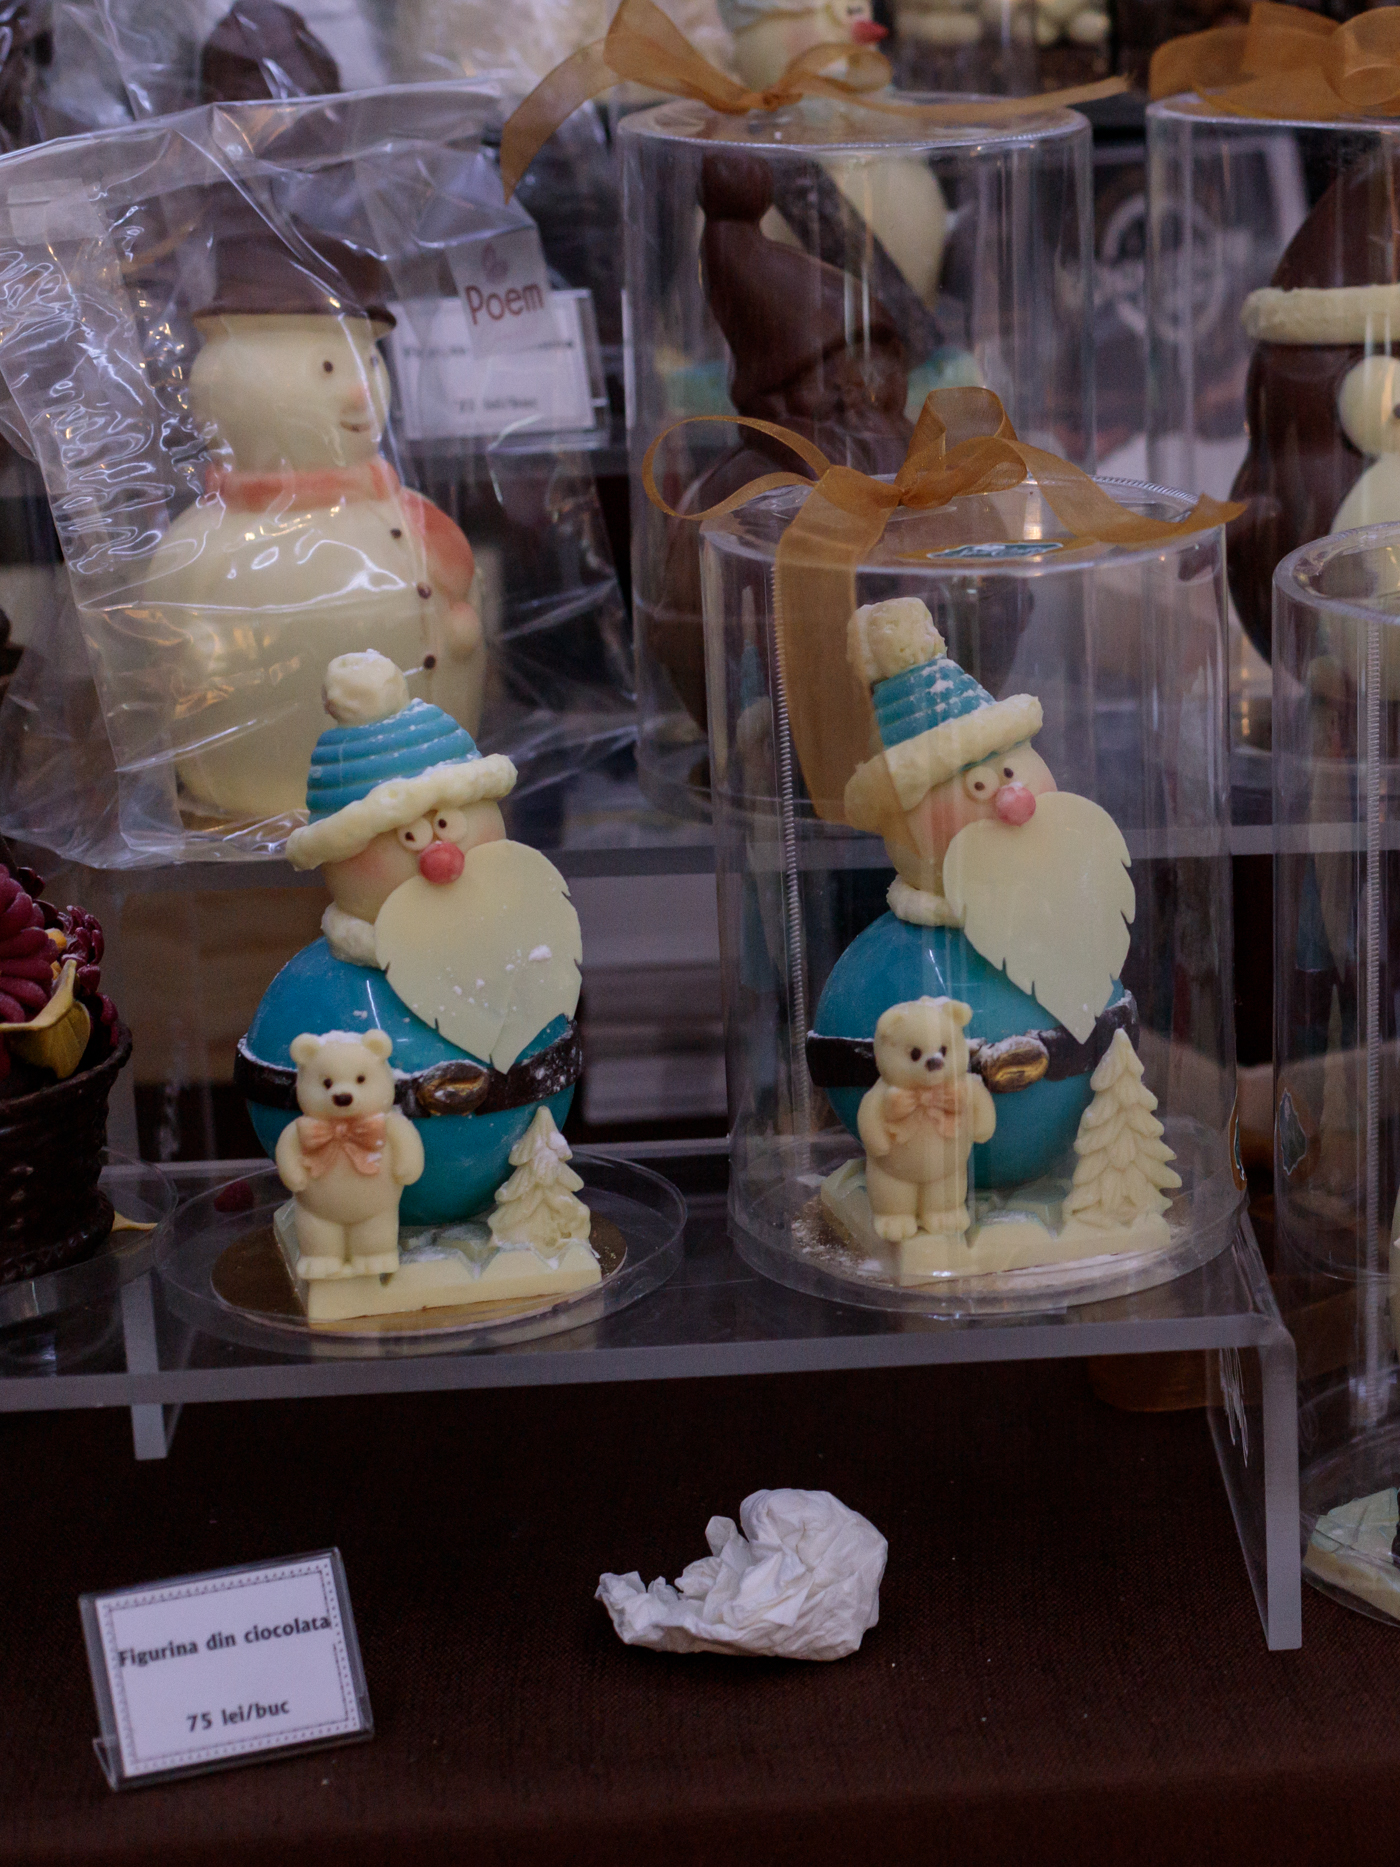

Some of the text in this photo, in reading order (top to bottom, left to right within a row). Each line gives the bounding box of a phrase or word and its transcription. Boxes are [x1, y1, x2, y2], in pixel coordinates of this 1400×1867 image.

[464, 283, 545, 326] Poem
[117, 1615, 332, 1668] Figurina din ciocolata
[186, 1700, 290, 1733] 75 lei/buc
